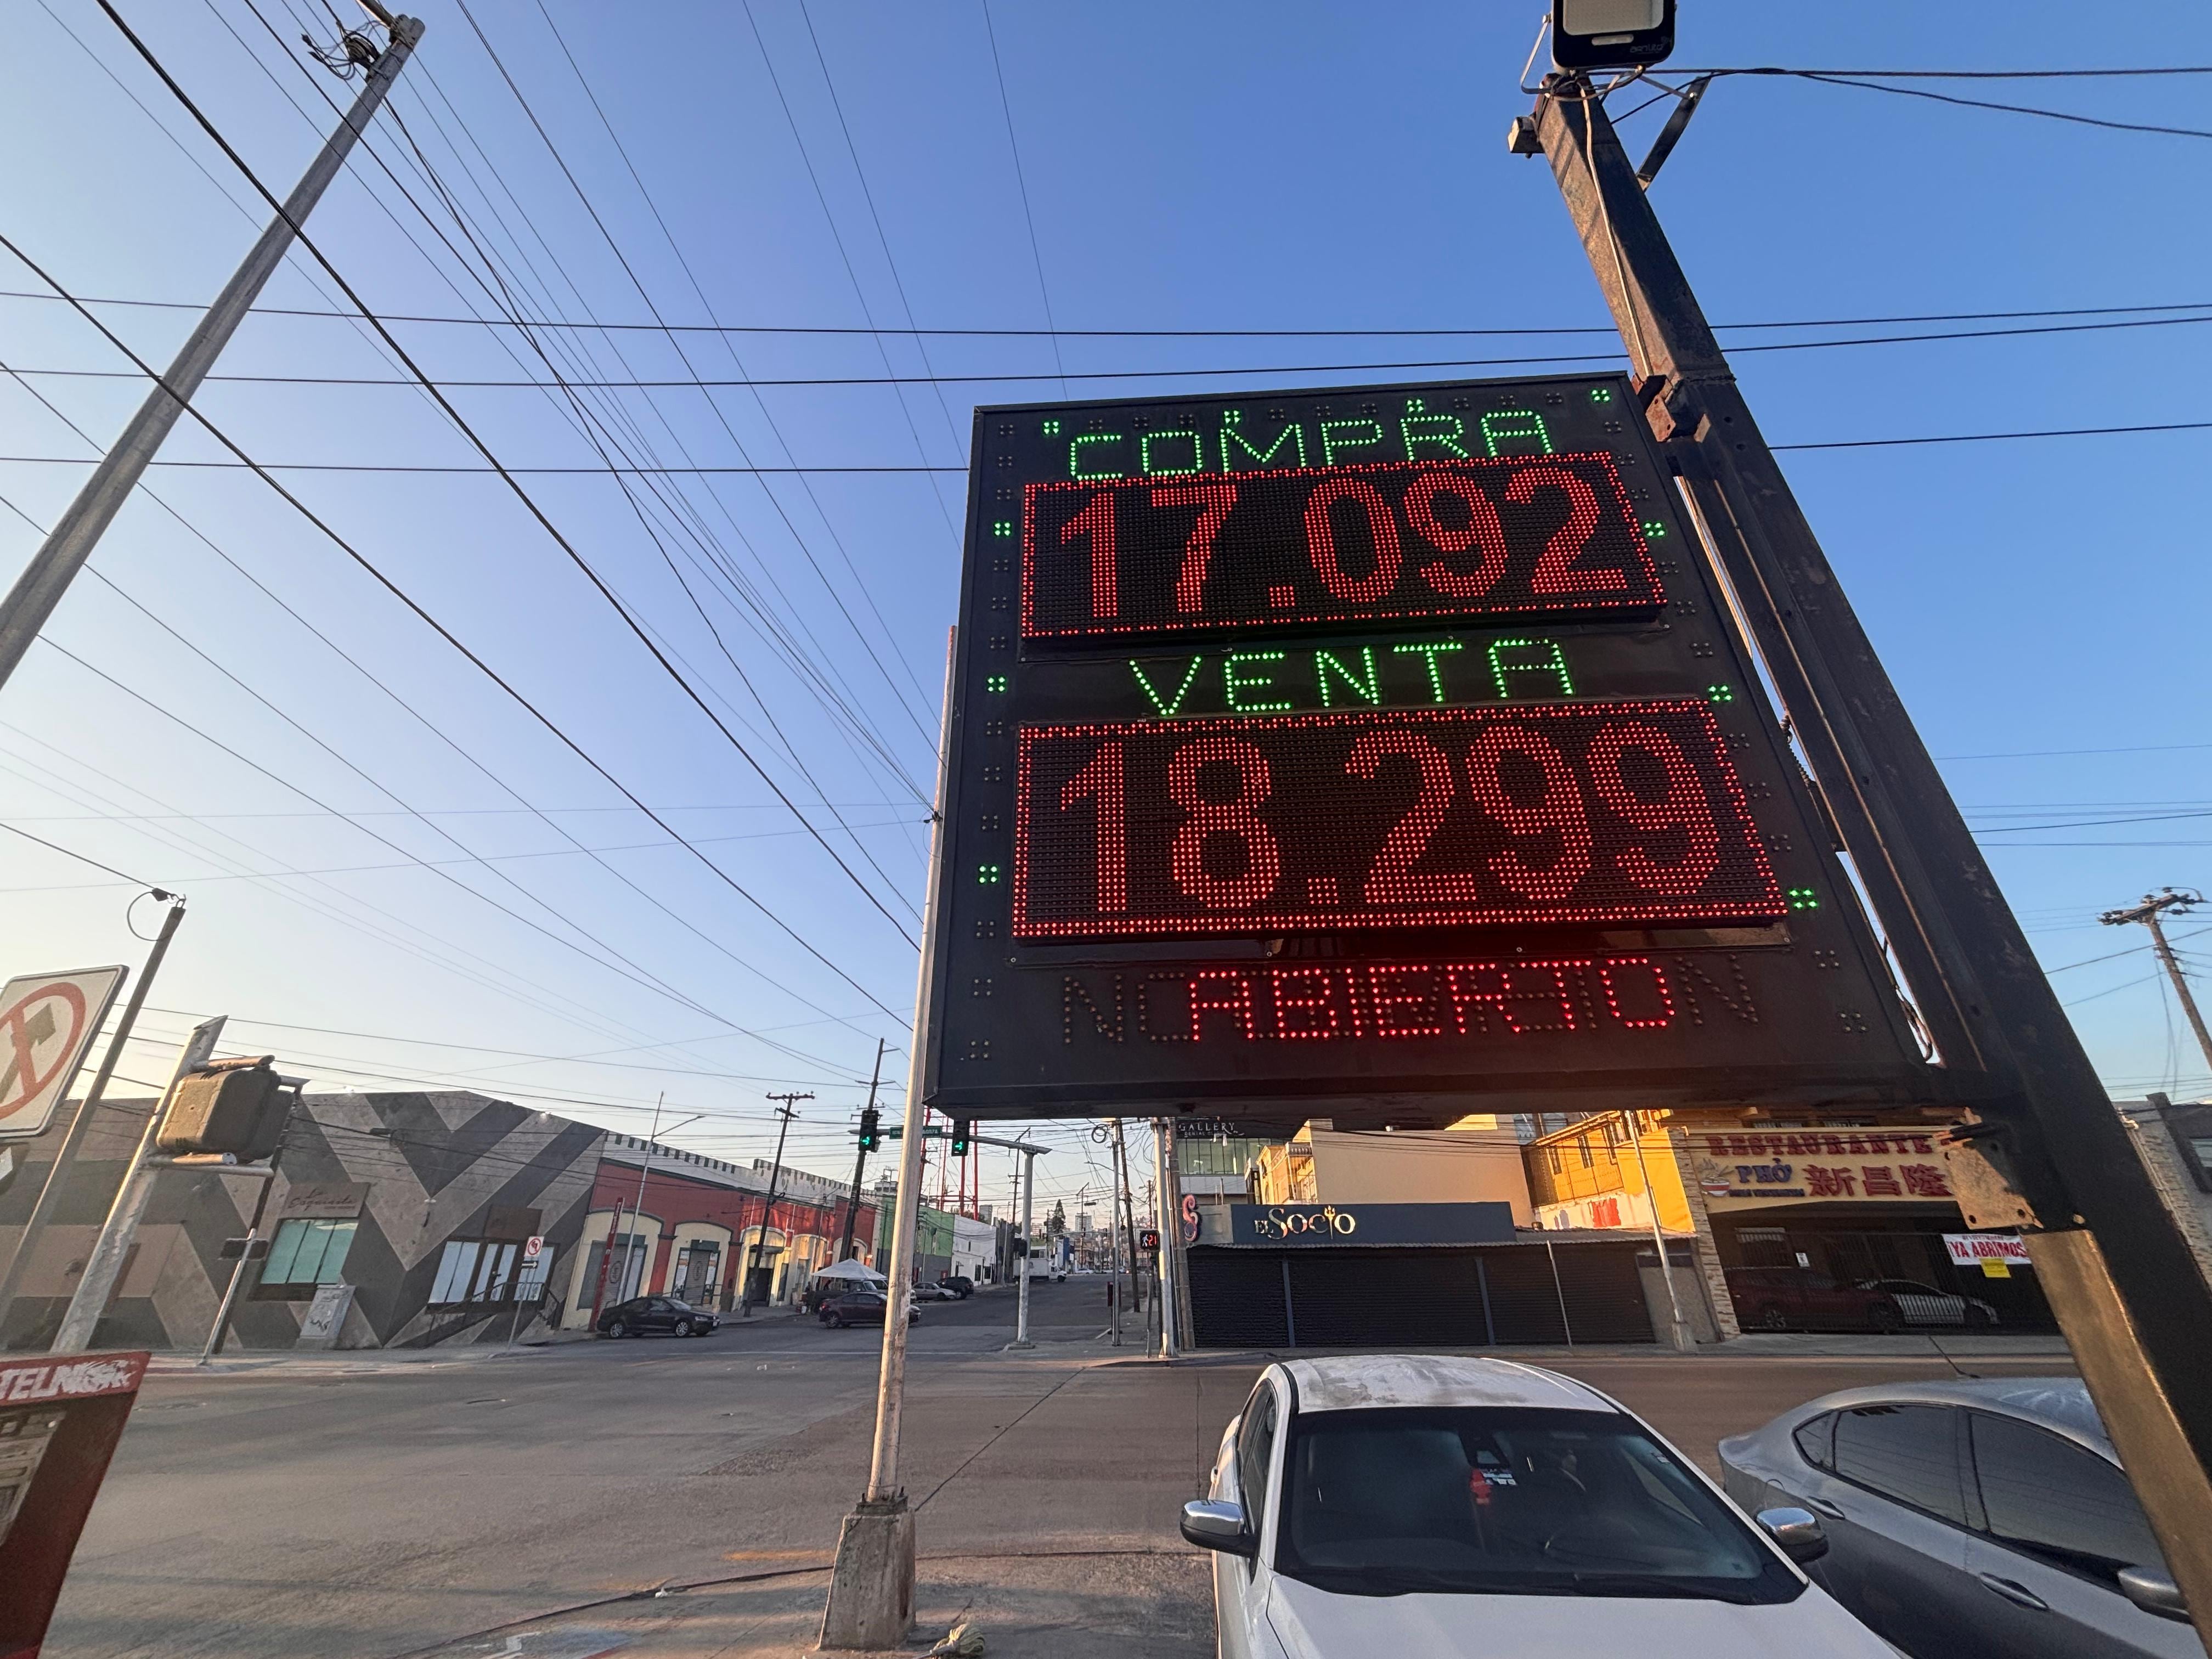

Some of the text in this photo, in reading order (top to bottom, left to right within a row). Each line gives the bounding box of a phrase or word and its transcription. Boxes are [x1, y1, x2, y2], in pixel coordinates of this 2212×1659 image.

[1070, 410, 1552, 481] COMPRA
[1060, 467, 1627, 618] 17.092
[1128, 639, 1573, 715] VENTA
[1059, 720, 1722, 911] 18.299
[1189, 957, 1676, 1042] ABIERTO
[1178, 1122, 1235, 1135] GALLERY
[1705, 1134, 1933, 1155] RESTAURANTE
[1803, 1164, 1955, 1197] 新昌隆
[1148, 1234, 1157, 1246] 21
[1971, 1242, 2028, 1258] ABRIMOS
